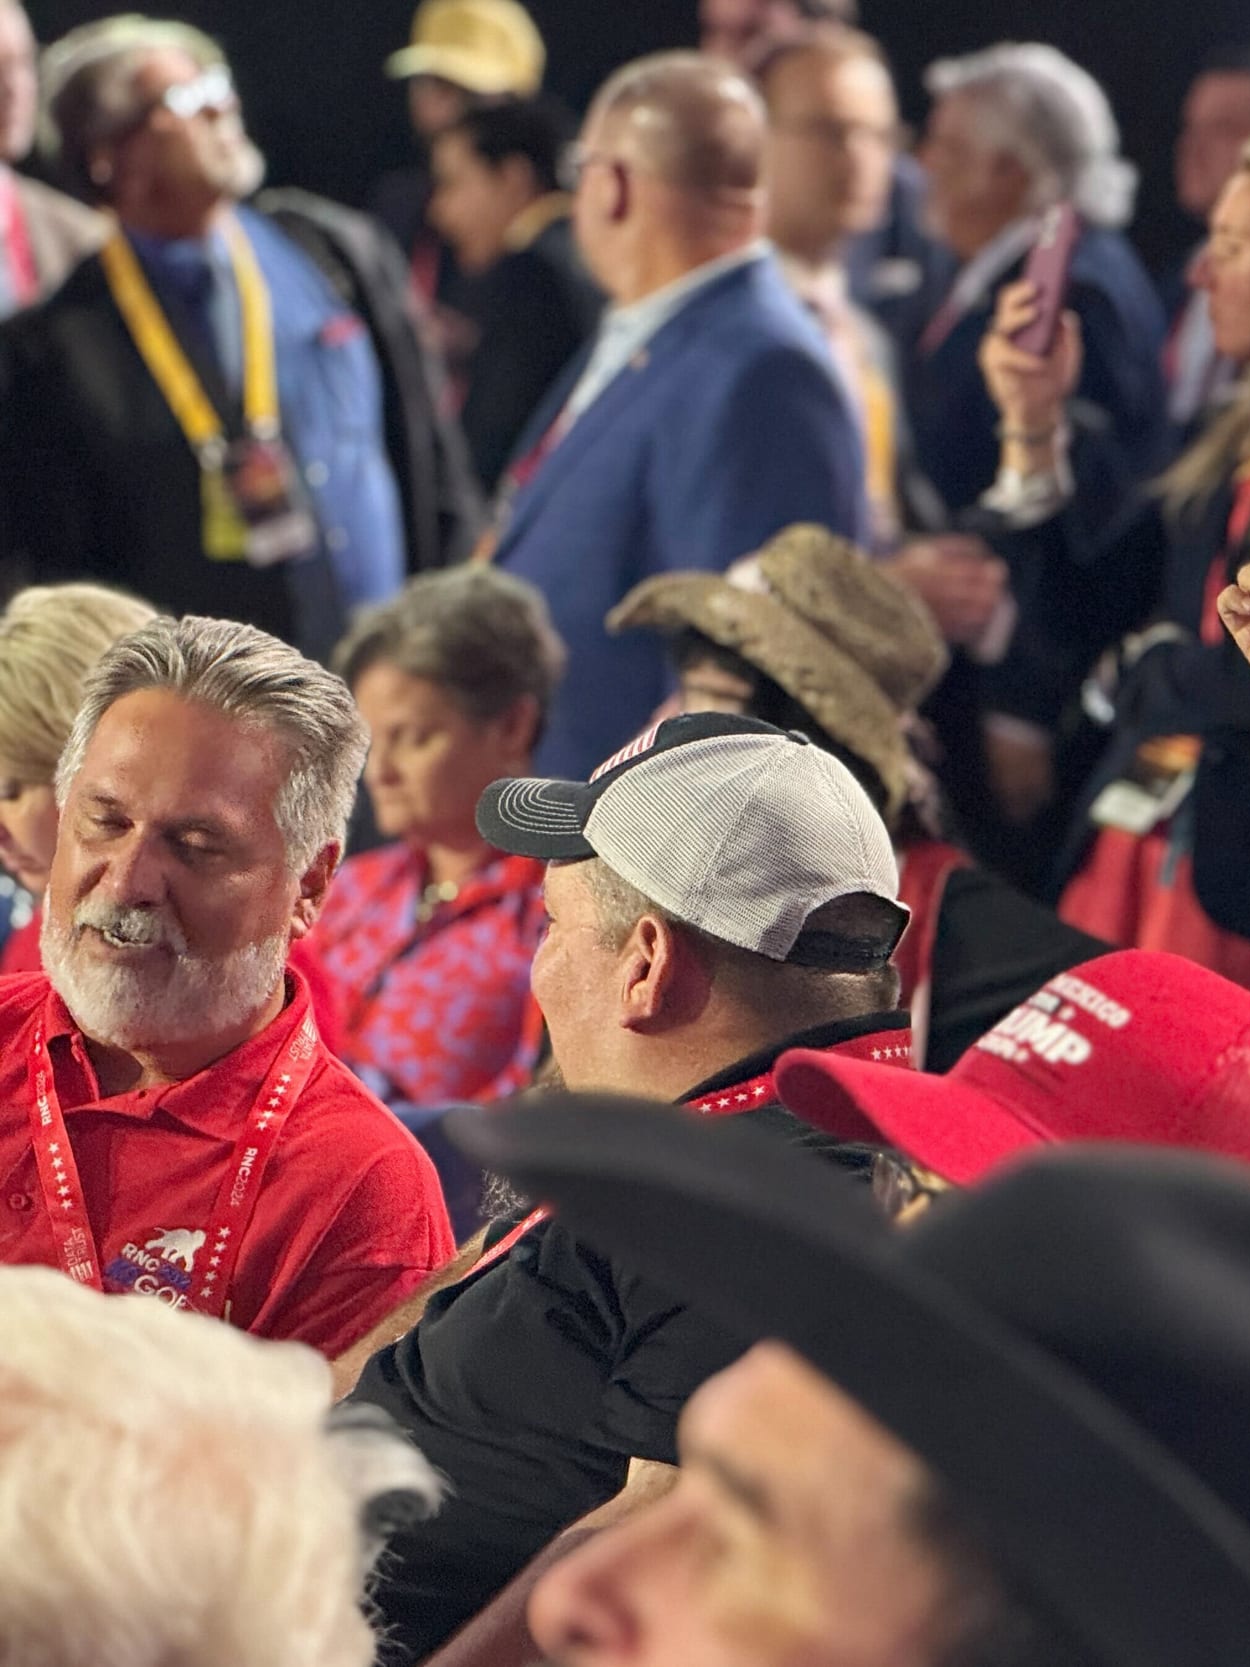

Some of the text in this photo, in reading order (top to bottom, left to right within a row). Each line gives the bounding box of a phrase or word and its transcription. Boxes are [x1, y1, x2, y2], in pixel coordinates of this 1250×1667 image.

[1046, 972, 1131, 1029] MEXICO
[993, 1007, 1092, 1065] UMP
[121, 1242, 160, 1272] RNC
